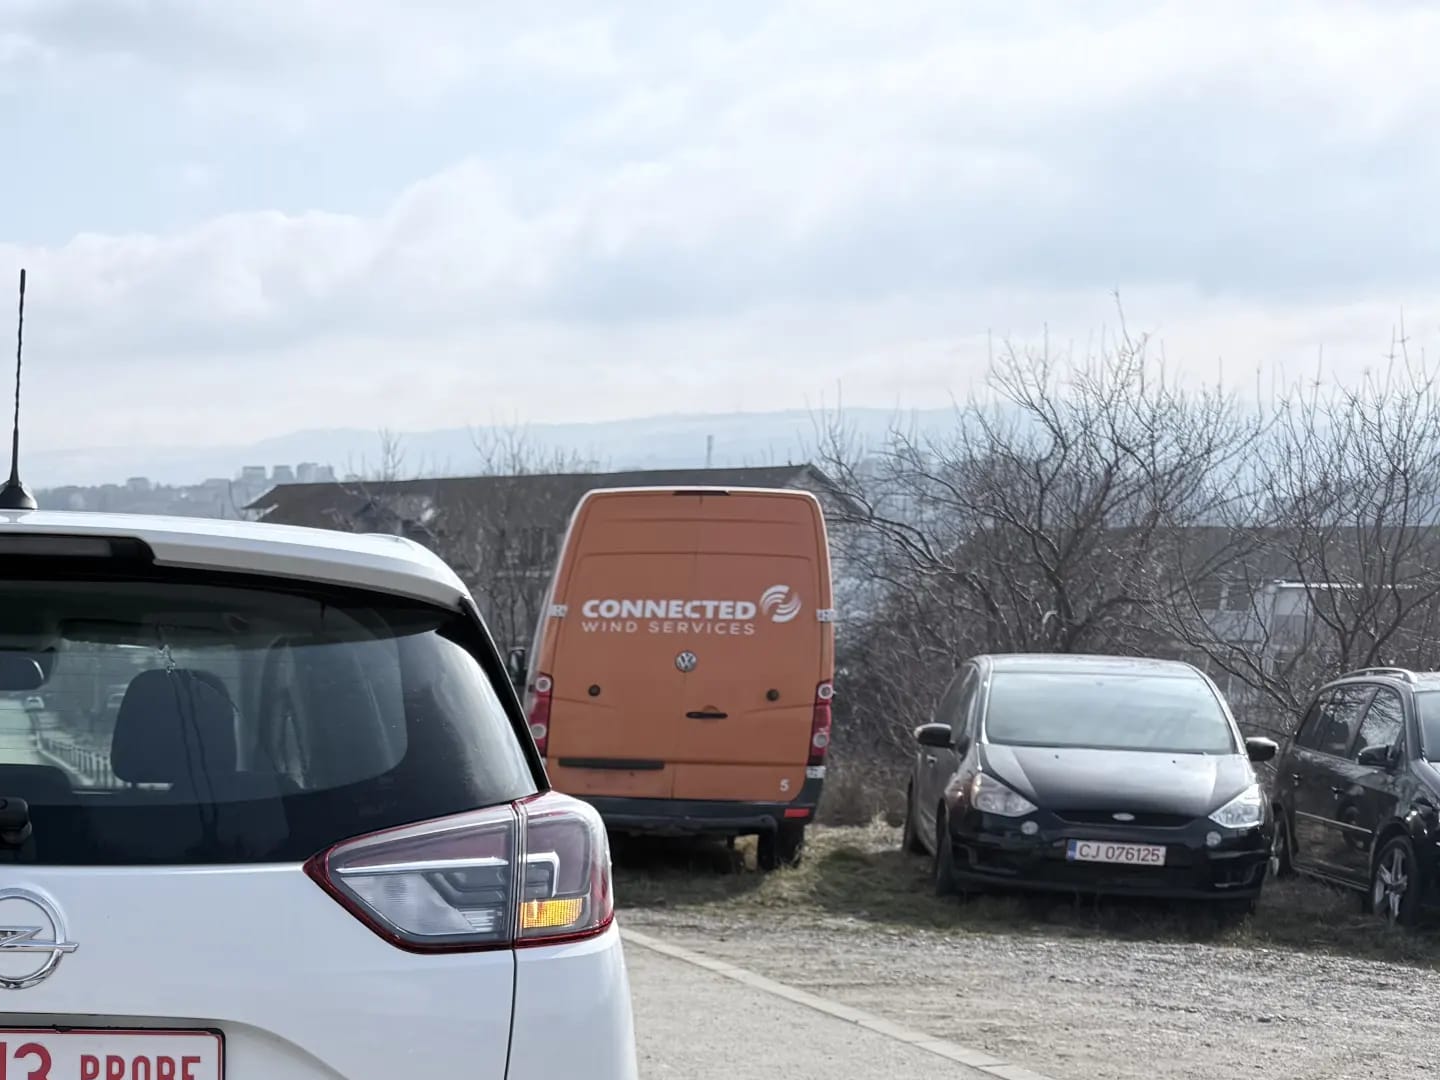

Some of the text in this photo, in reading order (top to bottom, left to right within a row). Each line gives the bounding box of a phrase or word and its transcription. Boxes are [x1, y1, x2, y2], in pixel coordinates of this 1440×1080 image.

[581, 599, 756, 620] CONNECTED
[582, 621, 755, 635] WIND SERVICES
[1079, 843, 1160, 862] CJ 076125
